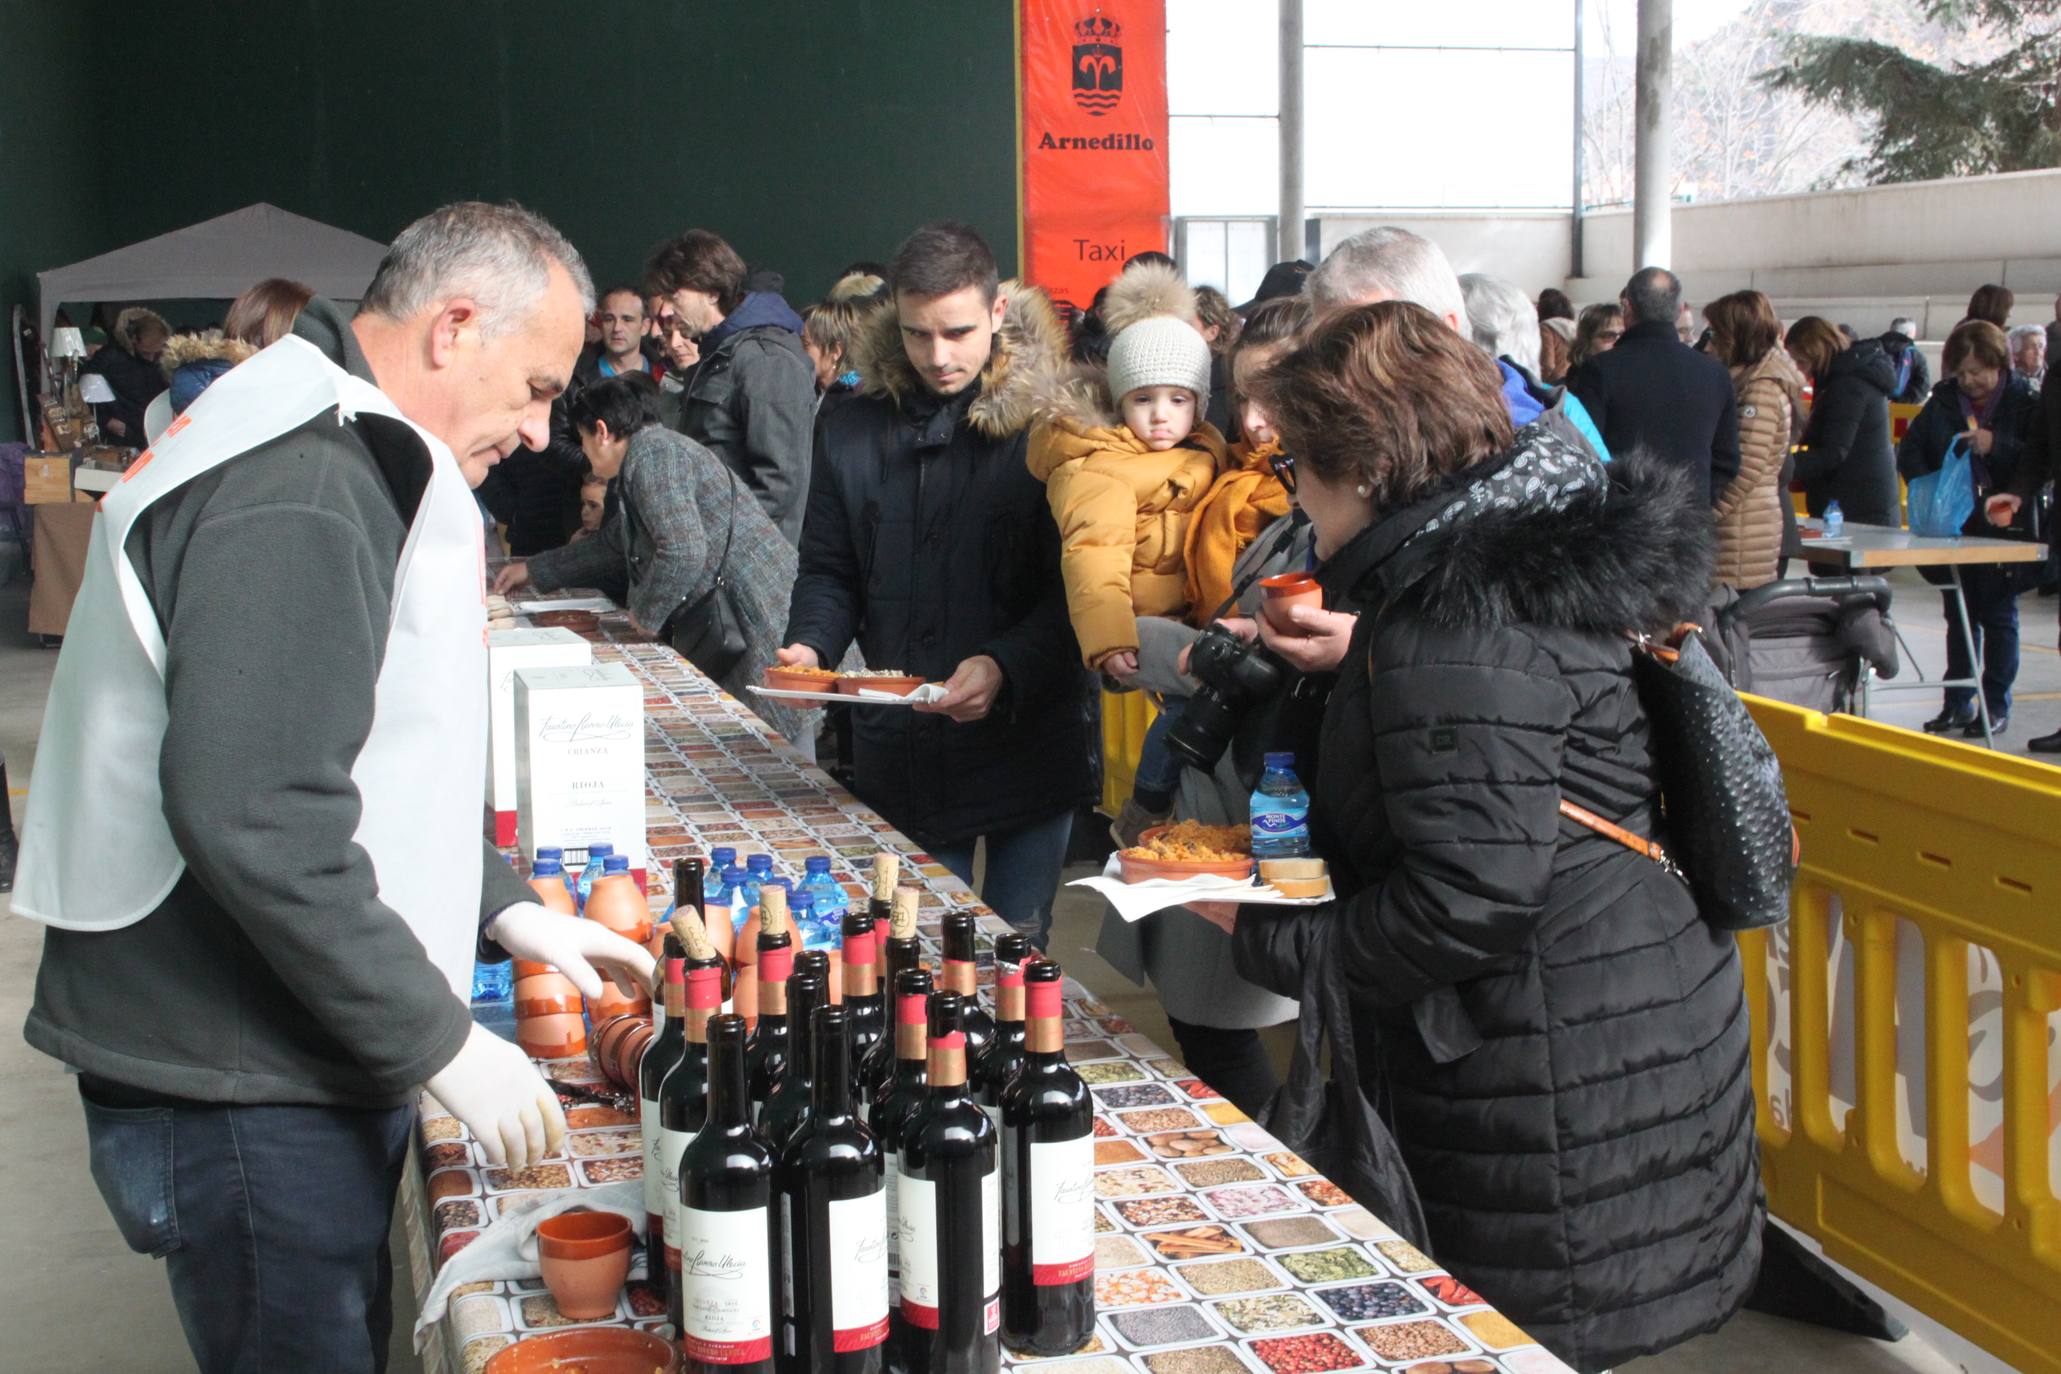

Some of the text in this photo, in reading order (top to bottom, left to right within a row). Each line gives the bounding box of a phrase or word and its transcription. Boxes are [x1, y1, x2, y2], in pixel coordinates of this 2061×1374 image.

[1038, 131, 1154, 151] Arnedillo
[1072, 239, 1125, 262] Taxi
[572, 780, 605, 790] RIOJA
